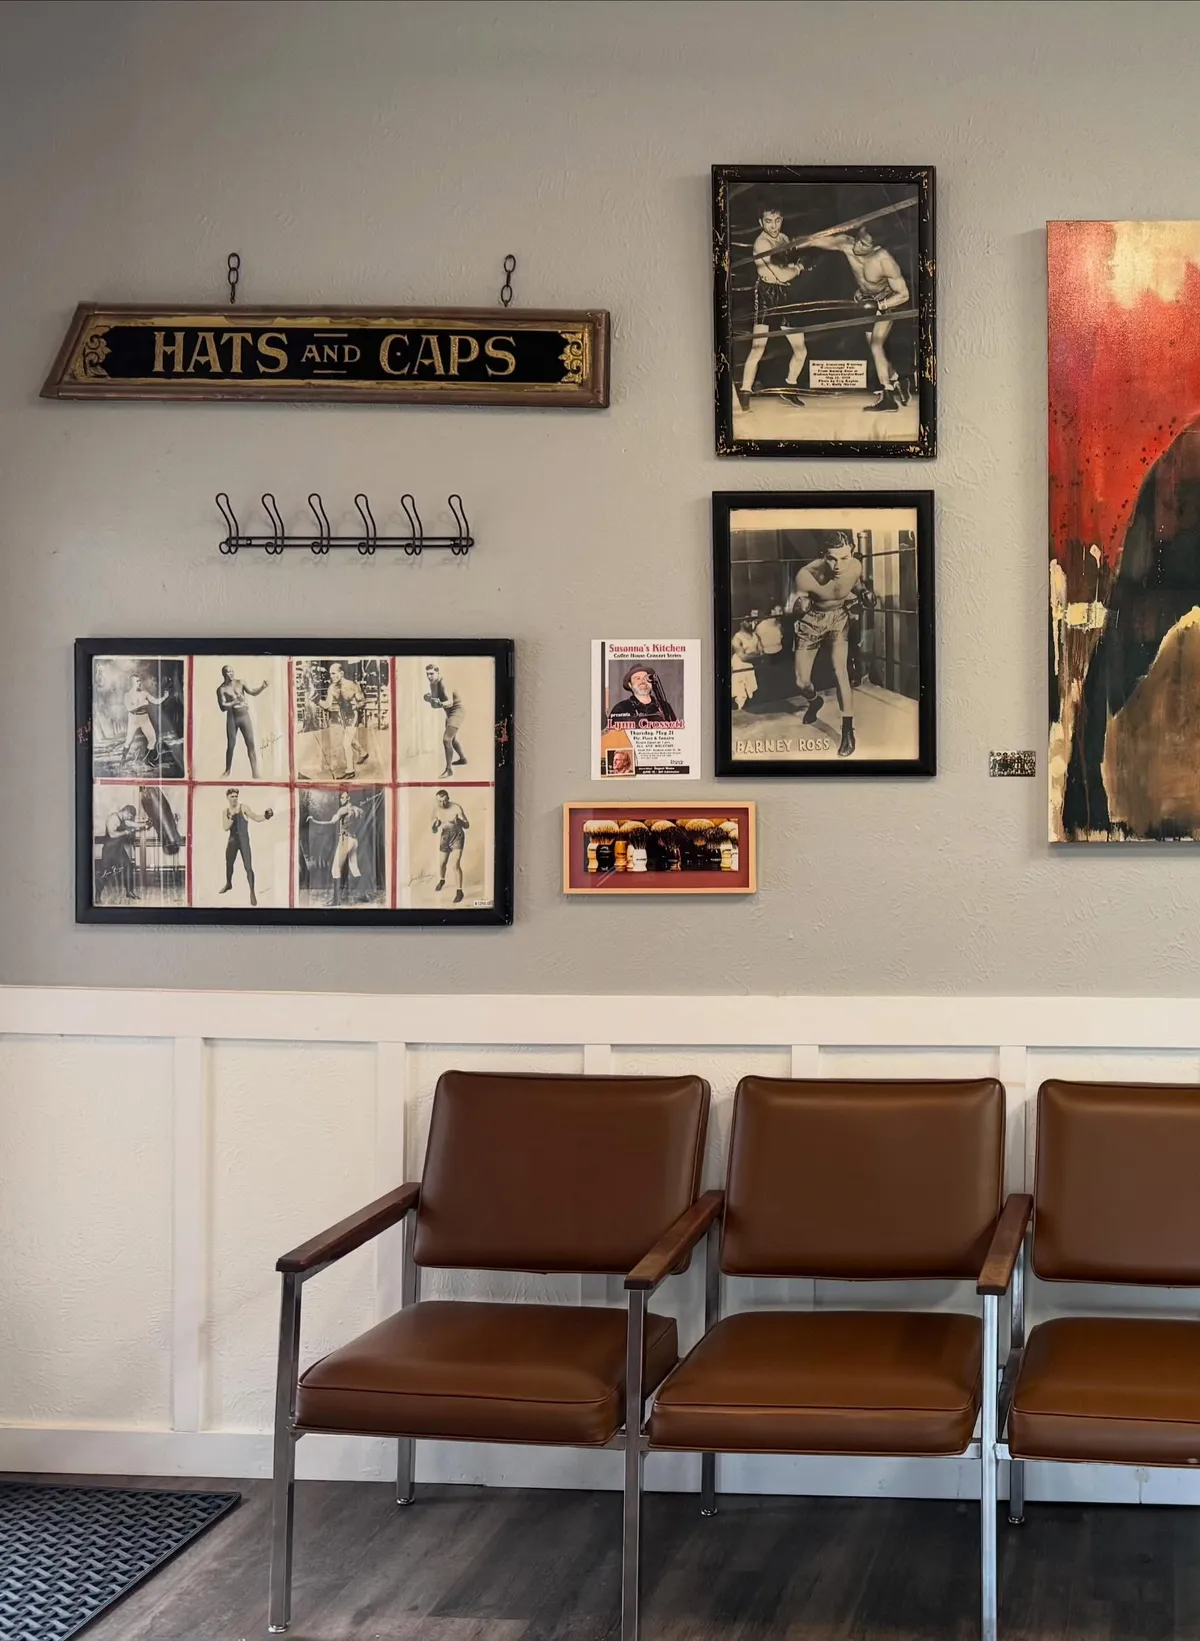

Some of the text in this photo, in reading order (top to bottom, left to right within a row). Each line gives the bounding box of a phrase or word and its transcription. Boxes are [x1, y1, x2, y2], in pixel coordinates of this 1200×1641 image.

[152, 331, 516, 377] HATS AND CAPS
[609, 643, 686, 653] Susanna's Kitchen
[736, 737, 830, 754] BARNEY ROSS
